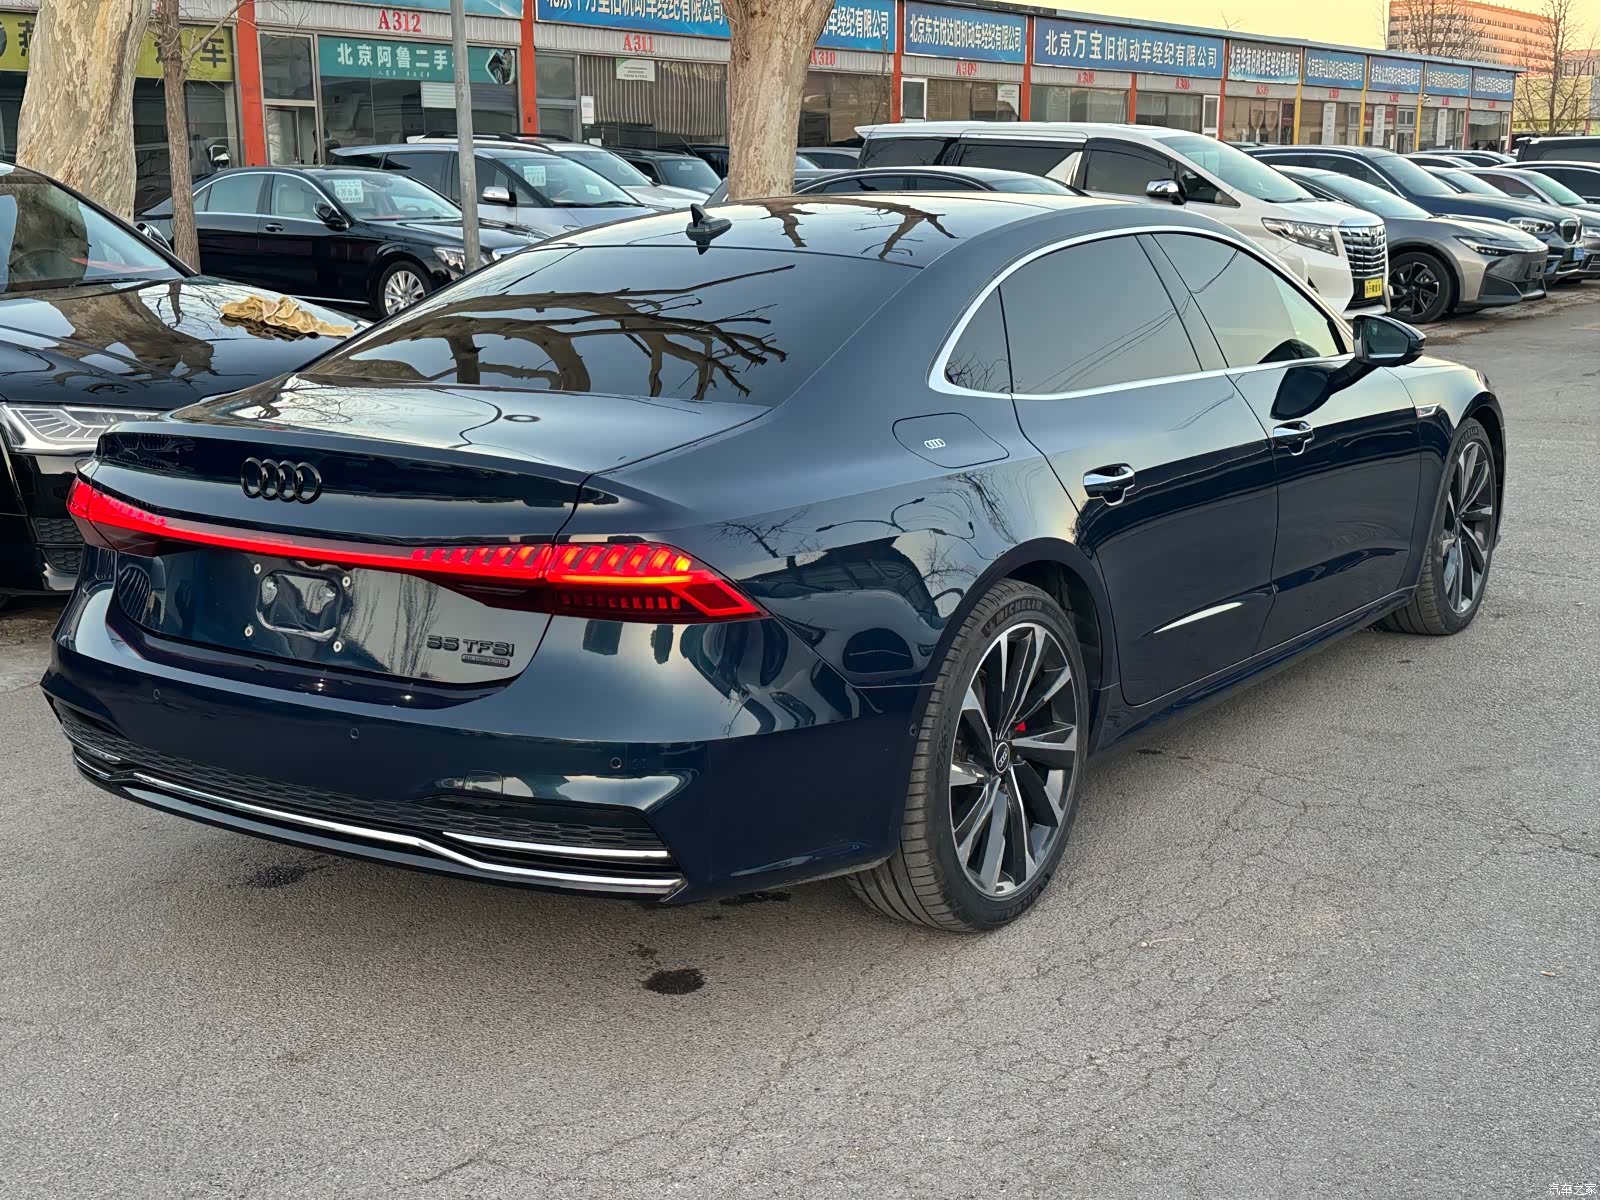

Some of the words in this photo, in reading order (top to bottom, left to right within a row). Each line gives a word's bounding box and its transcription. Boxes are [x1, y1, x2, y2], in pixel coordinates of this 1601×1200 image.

[379, 10, 422, 32] A312
[546, 0, 723, 25] 旧机动车经纪有限公司
[622, 33, 655, 53] A311
[1044, 29, 1217, 69] 北京万宝旧机动车经纪有限公司
[336, 42, 455, 71] 北京阿鲁二手
[810, 50, 836, 66] A310
[956, 61, 977, 77] A309
[426, 634, 460, 651] 55
[462, 638, 515, 657] TFSI
